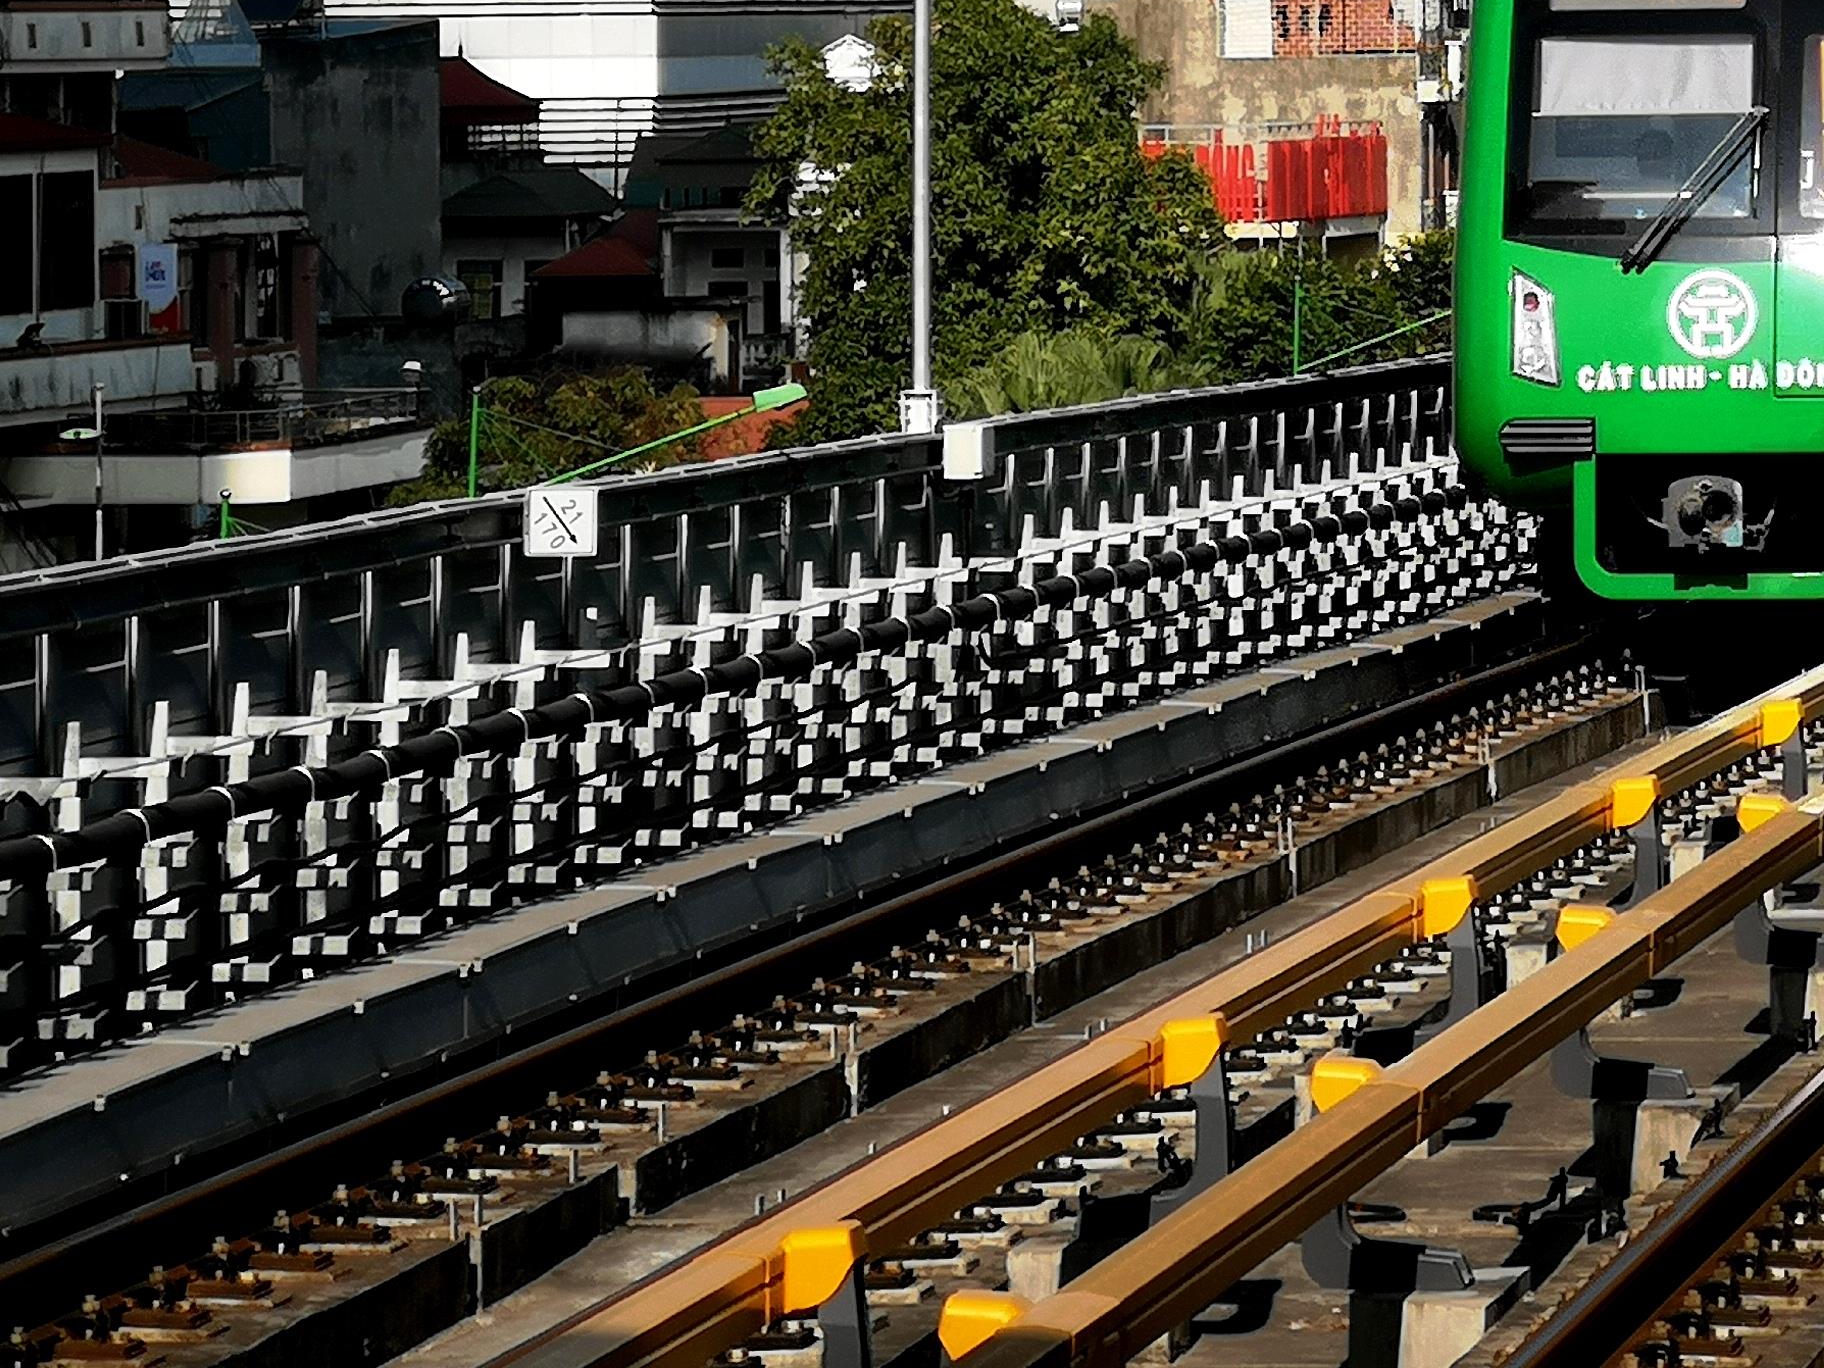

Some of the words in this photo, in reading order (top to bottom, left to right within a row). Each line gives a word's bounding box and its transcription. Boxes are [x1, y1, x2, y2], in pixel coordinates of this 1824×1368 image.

[1577, 361, 1634, 392] CÁT
[1640, 364, 1707, 392] LINH
[1728, 359, 1769, 390] HÀ
[560, 499, 583, 525] 21
[534, 512, 566, 549] 170
